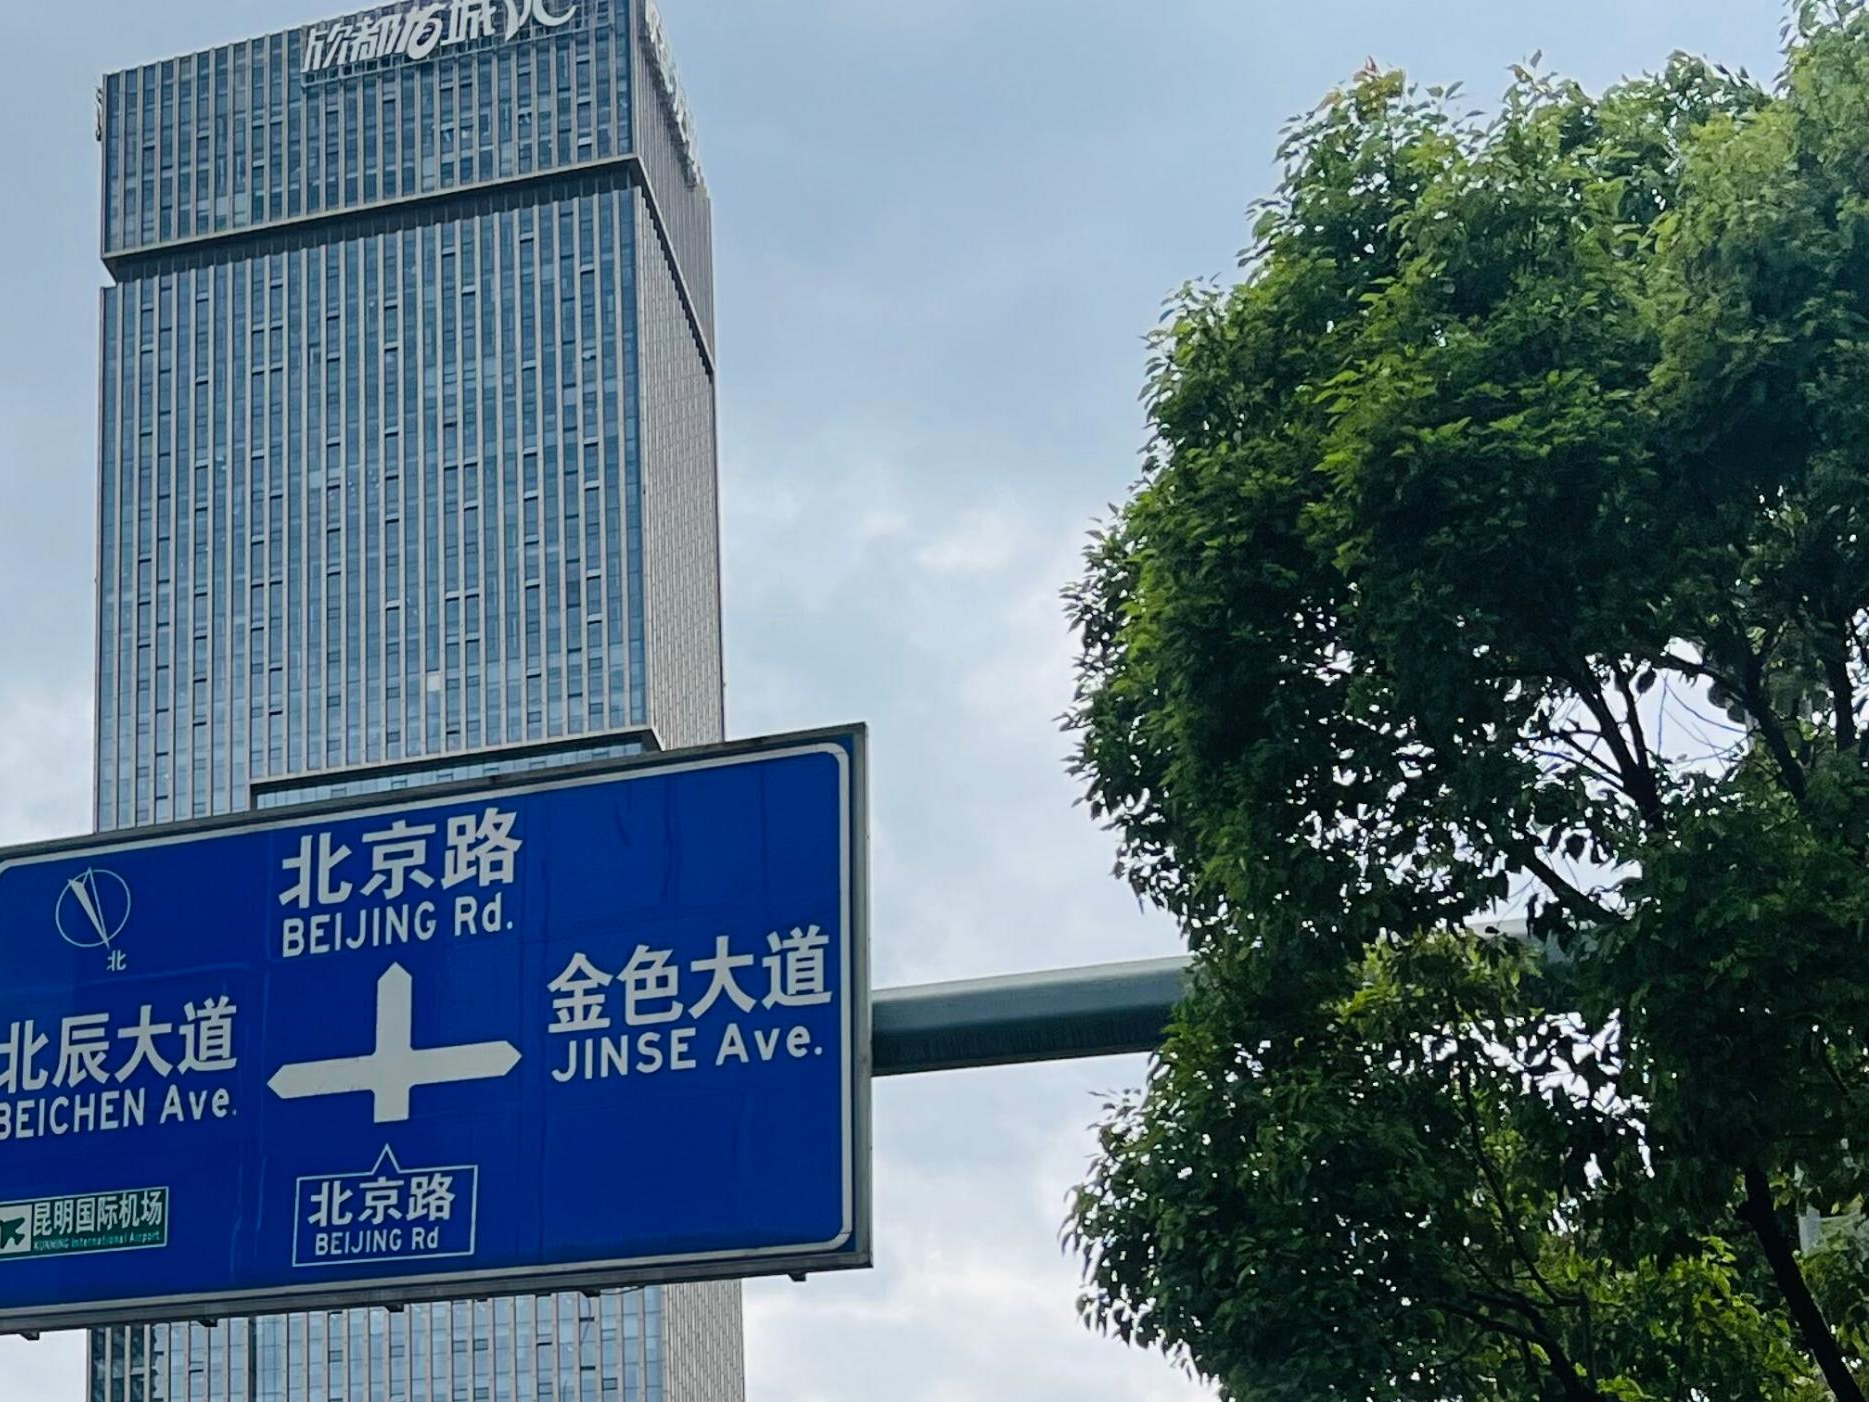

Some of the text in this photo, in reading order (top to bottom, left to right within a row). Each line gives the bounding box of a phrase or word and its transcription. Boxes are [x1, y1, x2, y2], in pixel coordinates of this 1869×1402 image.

[279, 808, 522, 909] 北京路
[283, 892, 513, 957] BEIJING Rd.
[107, 949, 127, 971] 北
[547, 925, 832, 1033] 金色大道
[551, 1023, 822, 1082] JINSE Ave.
[160, 1084, 237, 1124] Ave.
[33, 1191, 163, 1236] 昆明国际机场
[307, 1173, 456, 1227] 北京路
[315, 1226, 439, 1256] BEIJING Rd
